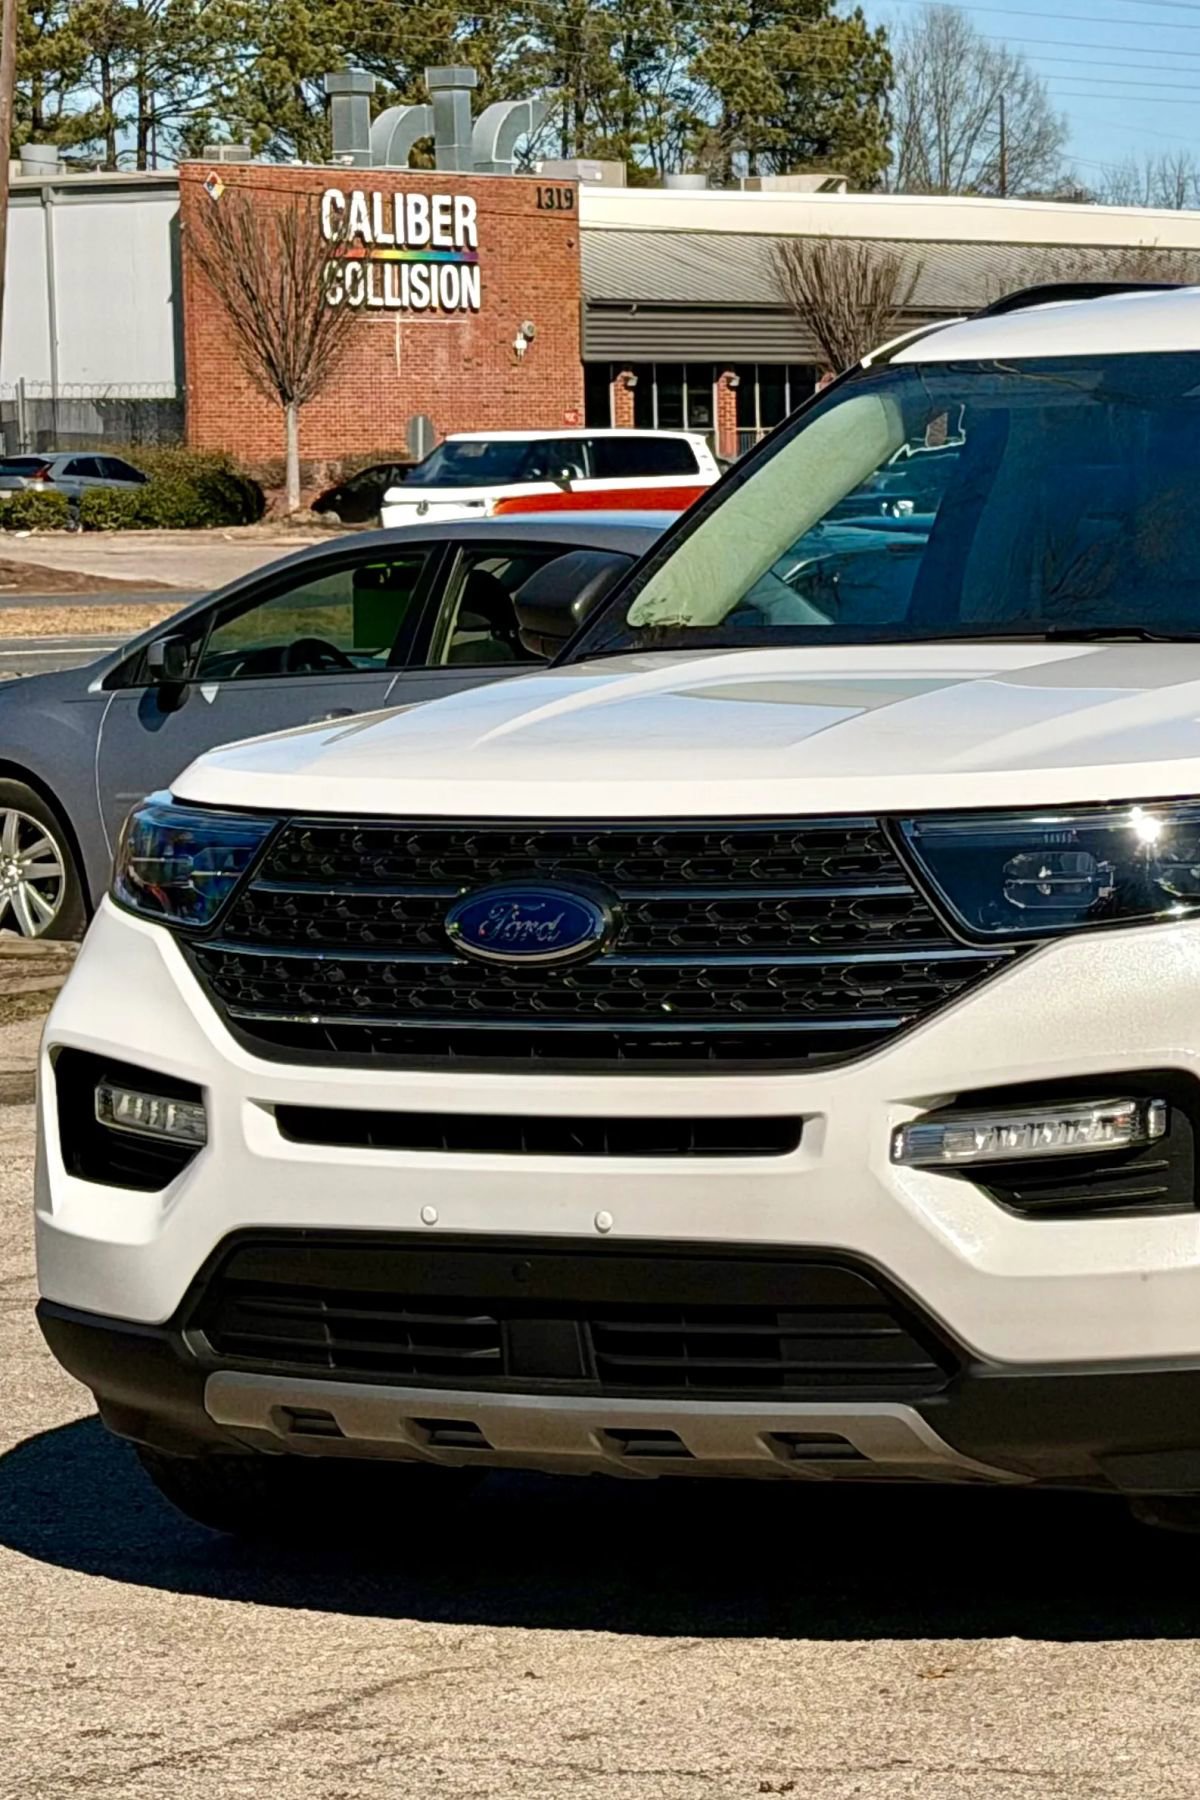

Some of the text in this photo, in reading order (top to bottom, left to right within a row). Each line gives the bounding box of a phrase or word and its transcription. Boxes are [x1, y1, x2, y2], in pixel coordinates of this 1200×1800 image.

[321, 188, 478, 248] CALIBER
[536, 186, 574, 210] 1319
[323, 260, 481, 310] COLLISION
[479, 902, 565, 941] Ford
